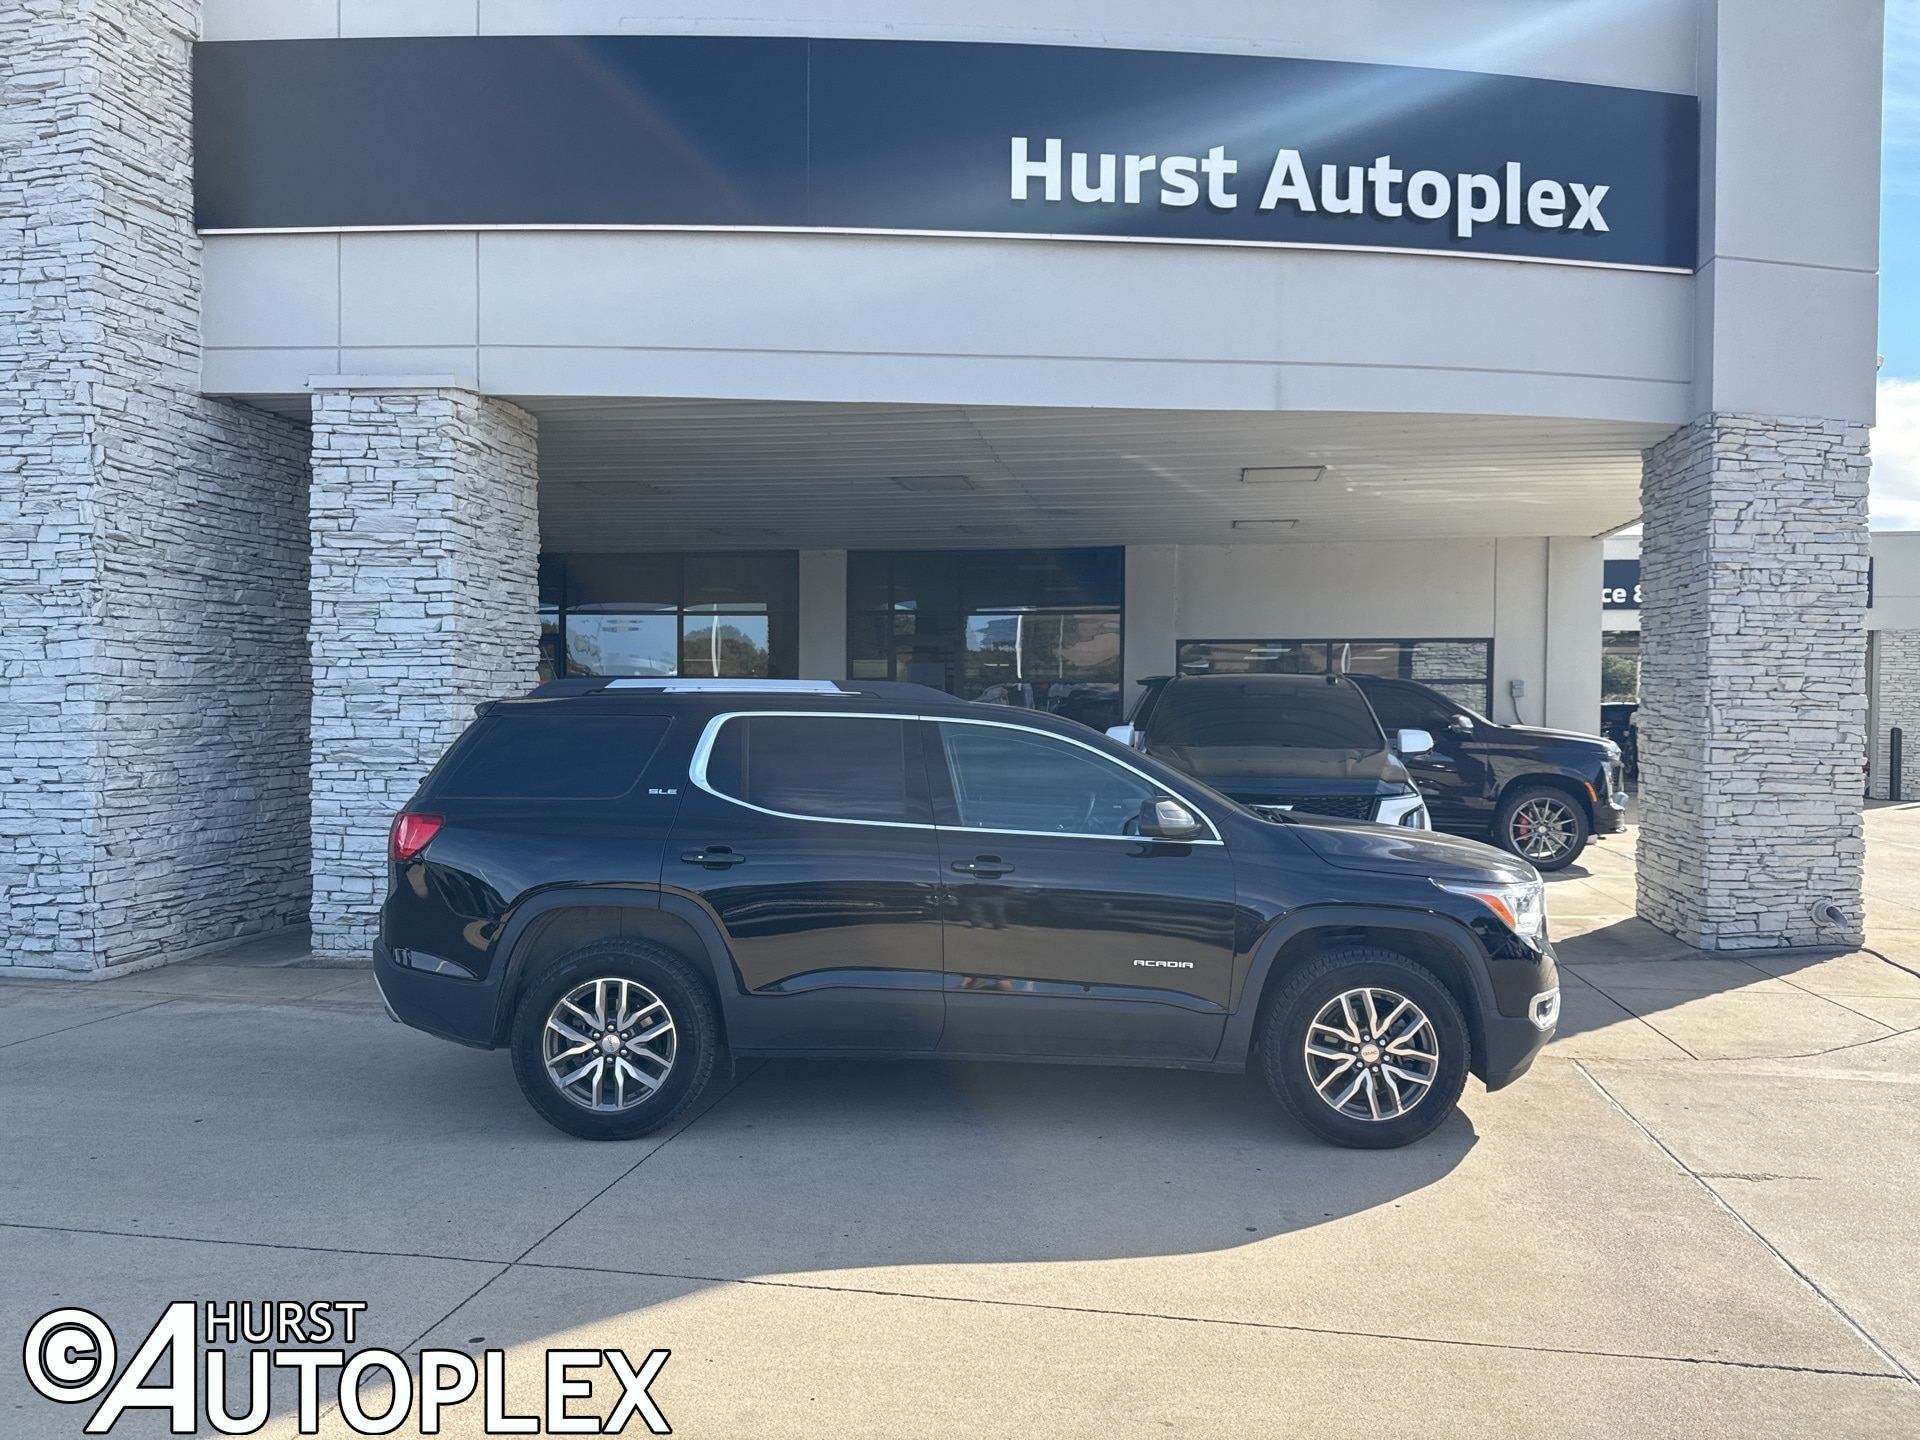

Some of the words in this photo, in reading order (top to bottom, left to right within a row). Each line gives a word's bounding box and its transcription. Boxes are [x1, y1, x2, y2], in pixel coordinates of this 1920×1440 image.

[1010, 137, 1238, 209] Hurst
[1259, 148, 1611, 238] Autoplex
[1133, 959, 1194, 969] ACADIA
